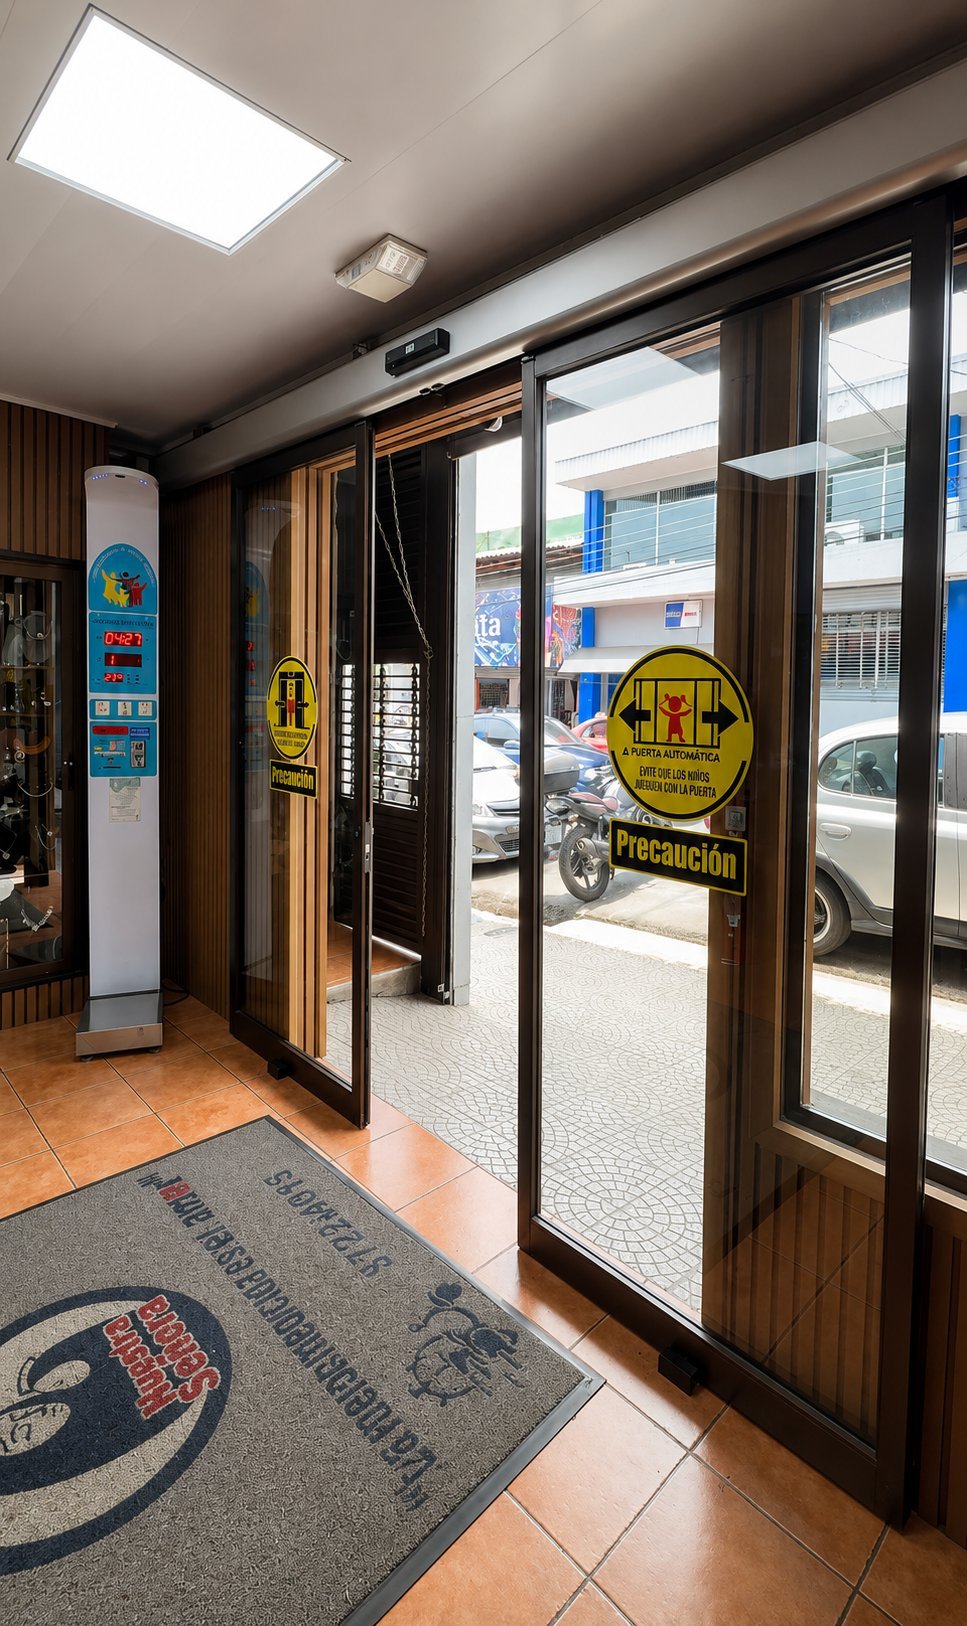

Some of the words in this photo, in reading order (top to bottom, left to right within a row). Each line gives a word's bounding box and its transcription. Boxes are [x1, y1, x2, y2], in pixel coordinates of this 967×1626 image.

[631, 747, 662, 758] PUERTA
[663, 749, 720, 763] AUTOMÁTICA
[272, 766, 314, 790] Precaución
[639, 766, 656, 777] EVITE
[658, 768, 671, 780] QUE
[672, 769, 686, 781] LOS
[664, 782, 678, 794] CON
[679, 785, 688, 795] LA
[689, 786, 717, 798] PUERTA
[616, 829, 737, 880] Precaución
[137, 1294, 219, 1402] Señora
[105, 1315, 183, 1418] Nuestra
